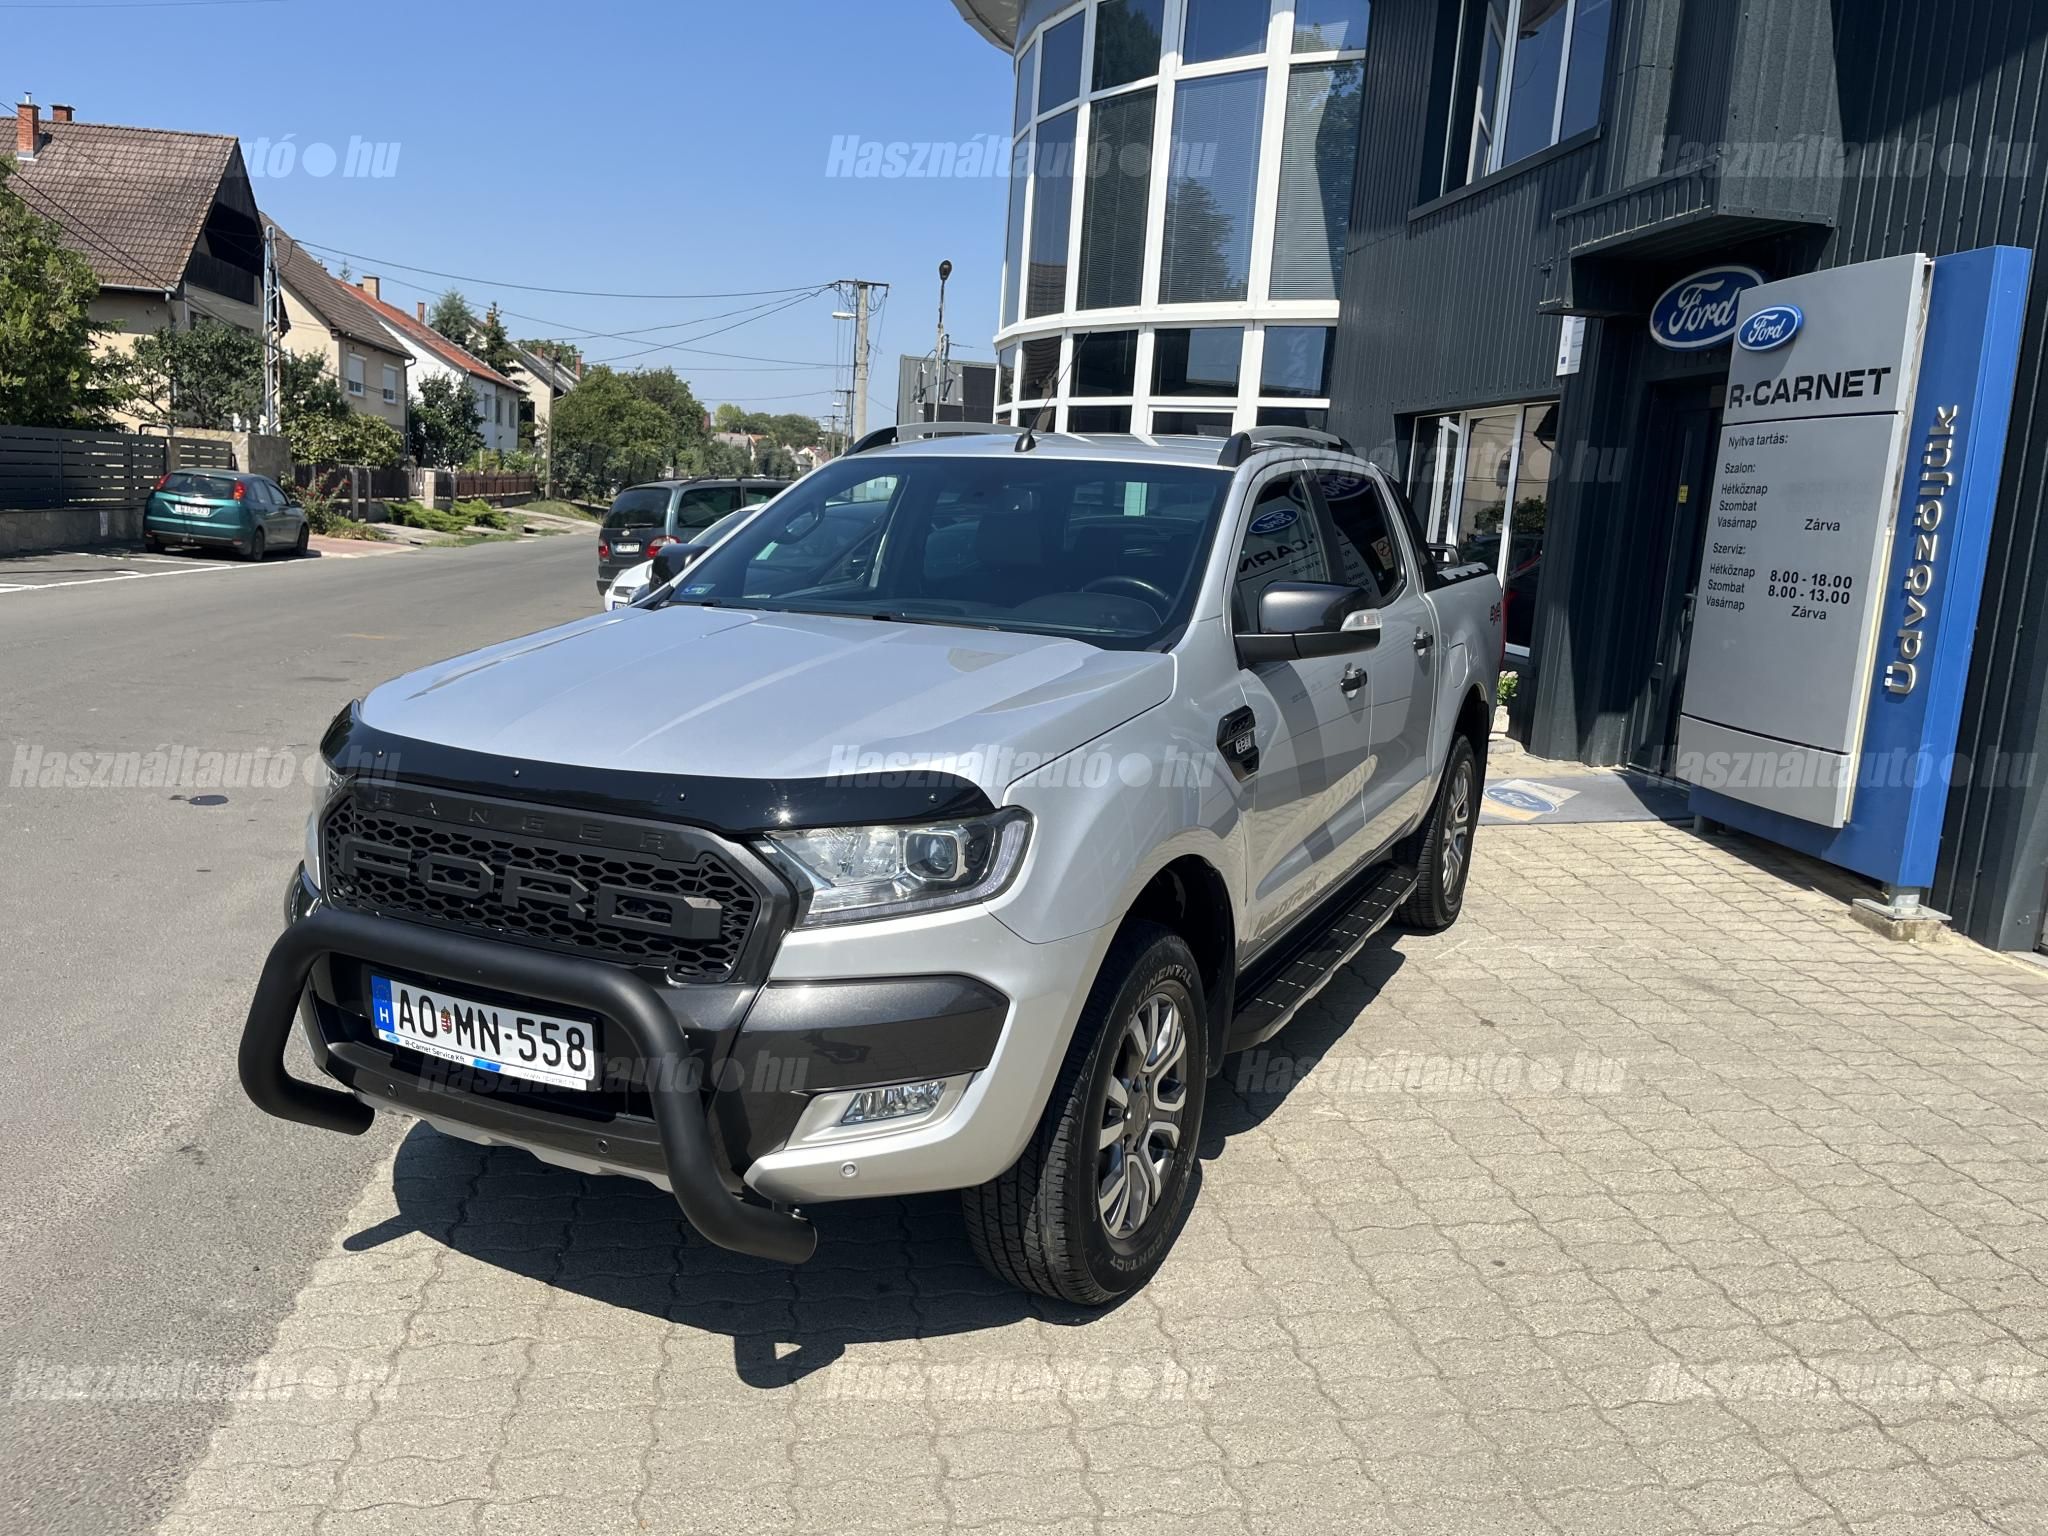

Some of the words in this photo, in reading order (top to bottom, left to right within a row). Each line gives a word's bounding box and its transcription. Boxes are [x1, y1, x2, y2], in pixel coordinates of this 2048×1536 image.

[1668, 279, 1740, 336] Ford
[1748, 313, 1786, 343] Ford
[1728, 366, 1891, 409] R-CARNET
[1728, 435, 1755, 449] Nyitva
[1756, 432, 1789, 445] tartás:
[1724, 463, 1756, 474] Szalon:
[1721, 483, 1768, 496] Hétköznap
[1719, 500, 1757, 511] Szombat
[1717, 516, 1757, 530] Vasárnap
[1804, 518, 1841, 532] Zárva
[1712, 542, 1746, 555] Szerviz:
[1884, 405, 1958, 695] Üdvözöljük
[1709, 563, 1755, 580] Hétköznap
[1770, 570, 1799, 584] 8.00
[1811, 573, 1853, 589] 18.00
[1707, 578, 1745, 593] Szombat
[1768, 585, 1797, 599] 8.00
[1809, 588, 1850, 604] 13.00
[1706, 595, 1745, 612] Vasárnap
[1791, 605, 1827, 620] Zárva
[373, 789, 666, 851] RANGER
[339, 833, 723, 940] FORD
[379, 1006, 390, 1024] H
[399, 989, 438, 1038] AO
[453, 1003, 587, 1072] MN-558
[404, 1040, 432, 1053] R-Carnet
[432, 1048, 455, 1060] Service
